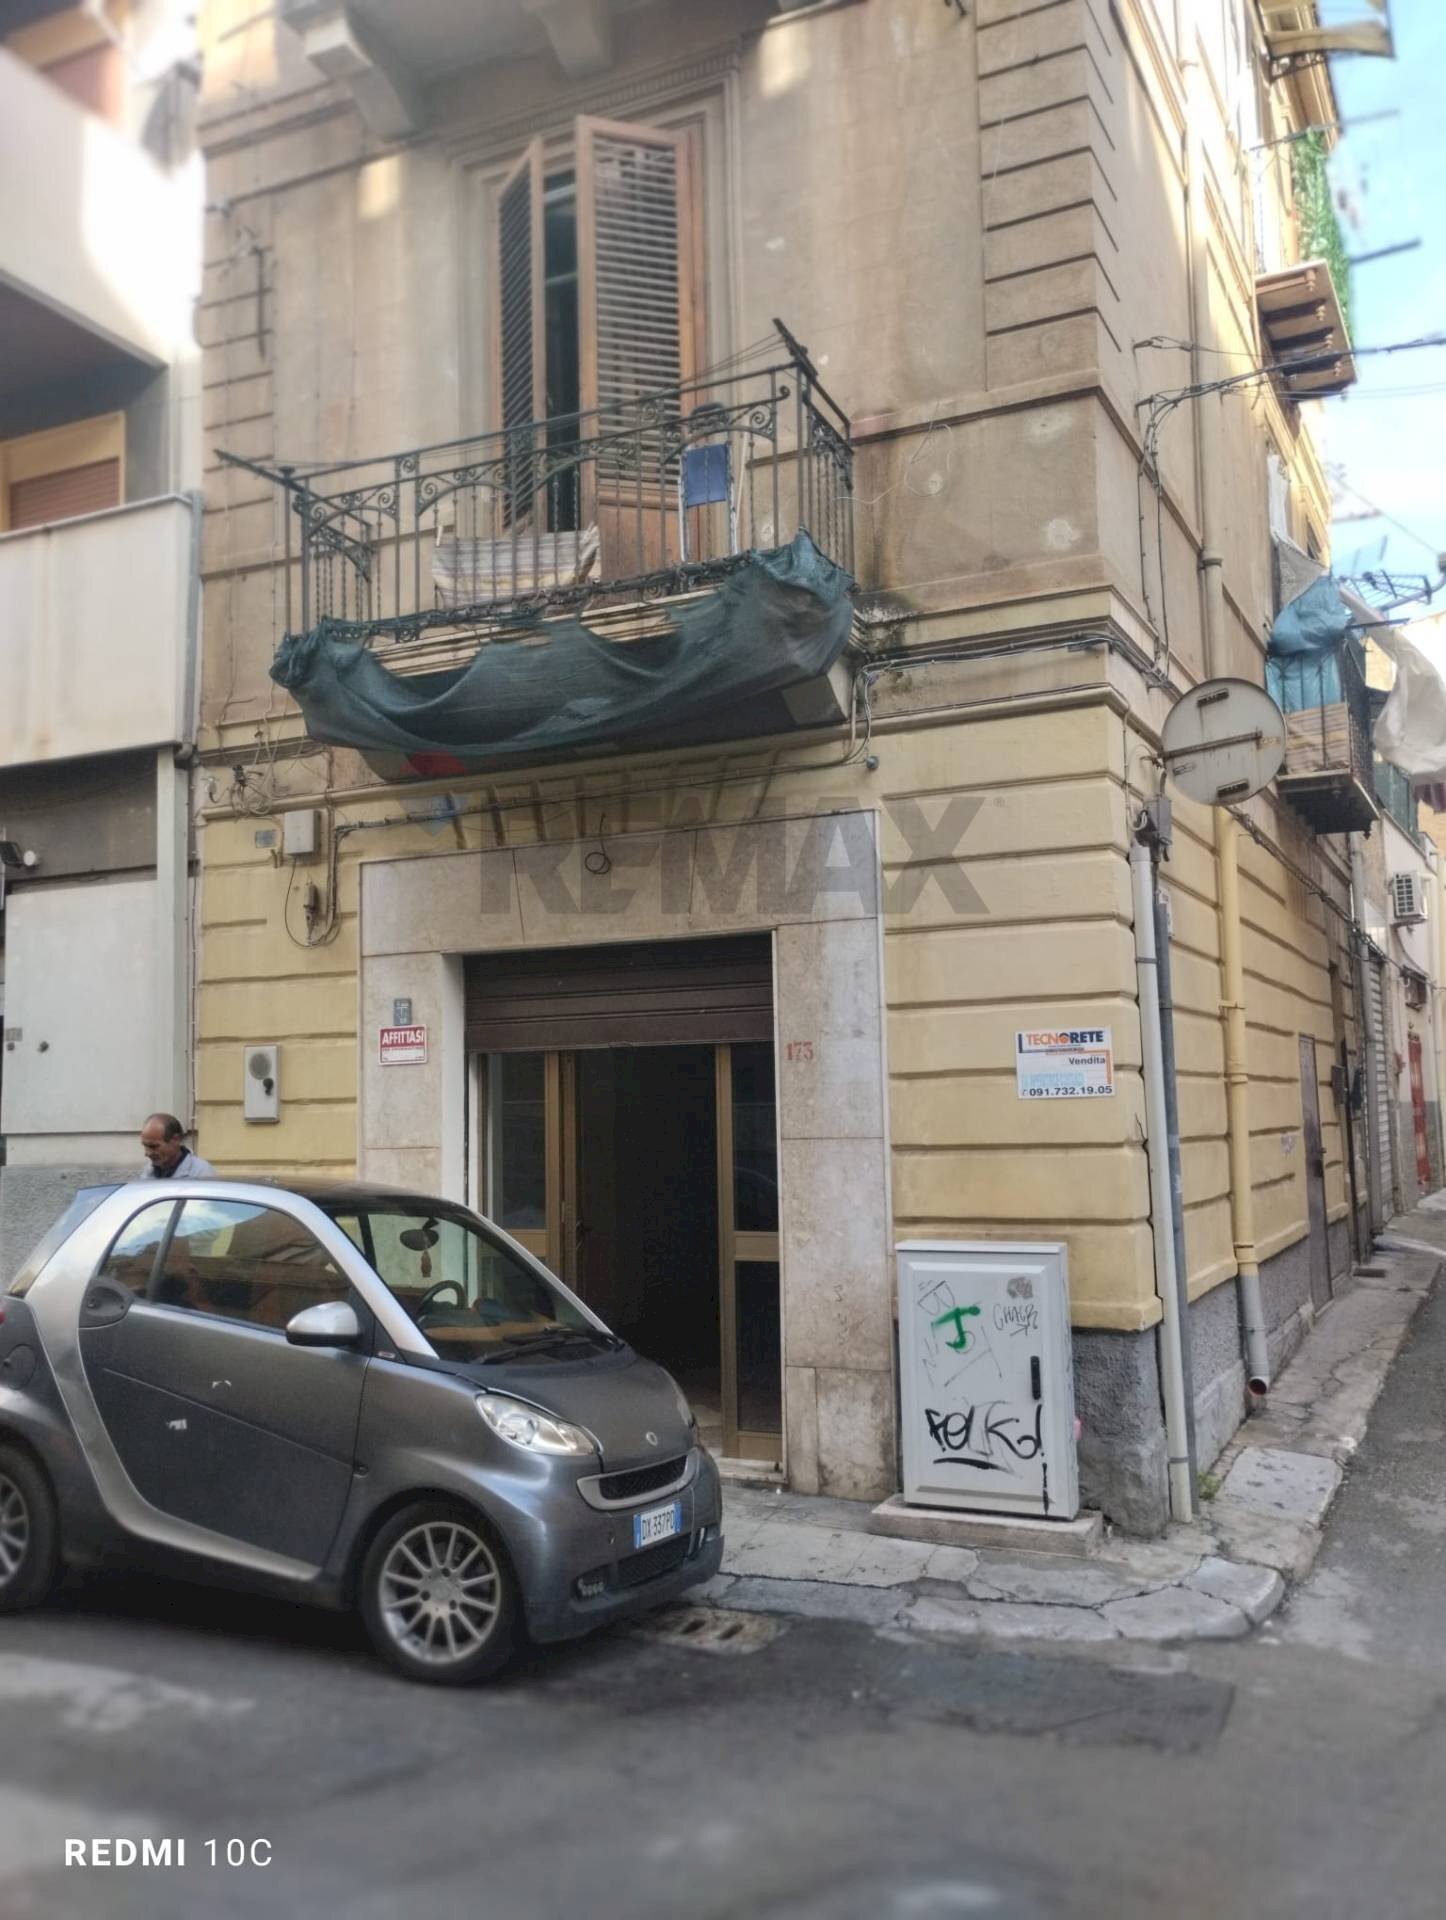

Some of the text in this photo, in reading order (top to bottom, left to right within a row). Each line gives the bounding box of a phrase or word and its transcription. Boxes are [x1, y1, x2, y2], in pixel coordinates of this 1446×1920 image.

[382, 1029, 425, 1046] AFFITTASI
[1026, 1030, 1104, 1046] TECNORETE
[1068, 1056, 1106, 1065] Vendita
[1029, 1085, 1113, 1097] 091.732.19.05
